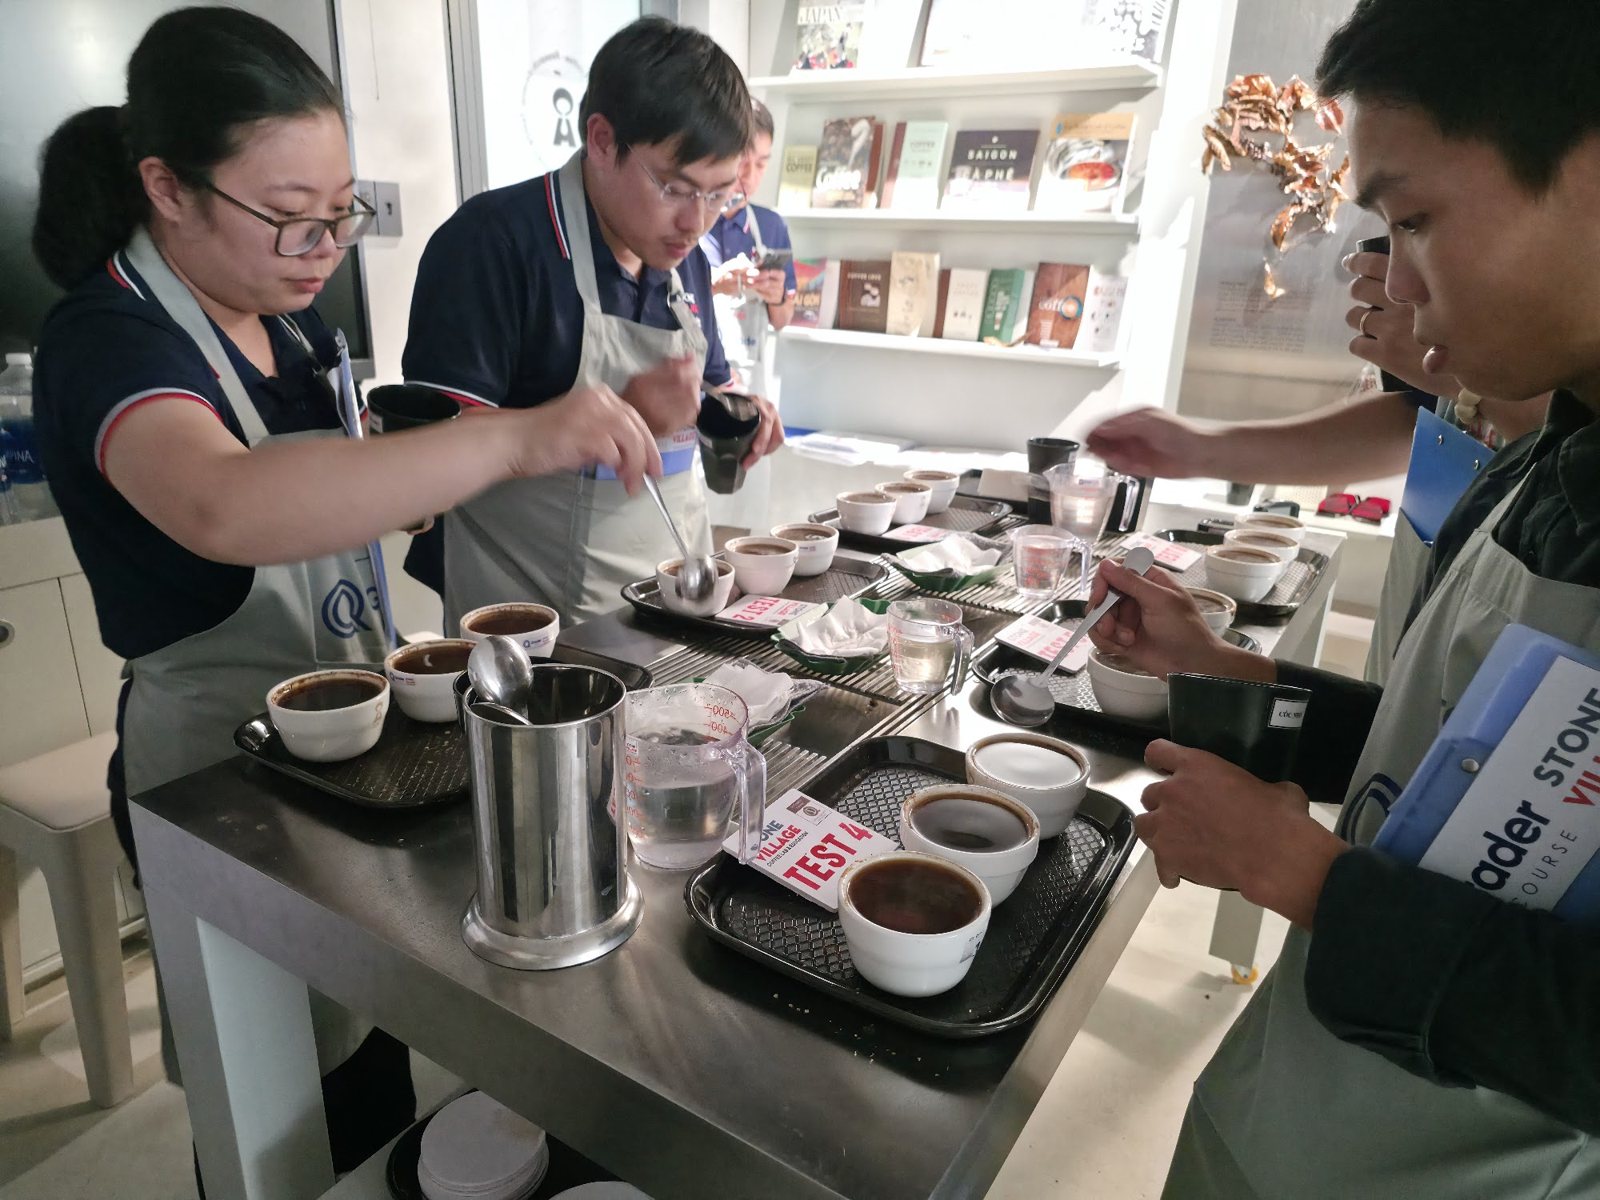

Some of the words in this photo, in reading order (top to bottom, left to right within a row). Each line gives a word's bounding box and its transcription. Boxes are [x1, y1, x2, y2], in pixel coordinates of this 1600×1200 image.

[967, 149, 1018, 160] SAIGON
[742, 597, 780, 615] TEST
[757, 825, 801, 861] VILLAGE
[783, 833, 857, 890] TEST
[839, 822, 873, 841] 4
[1467, 800, 1550, 891] ader
